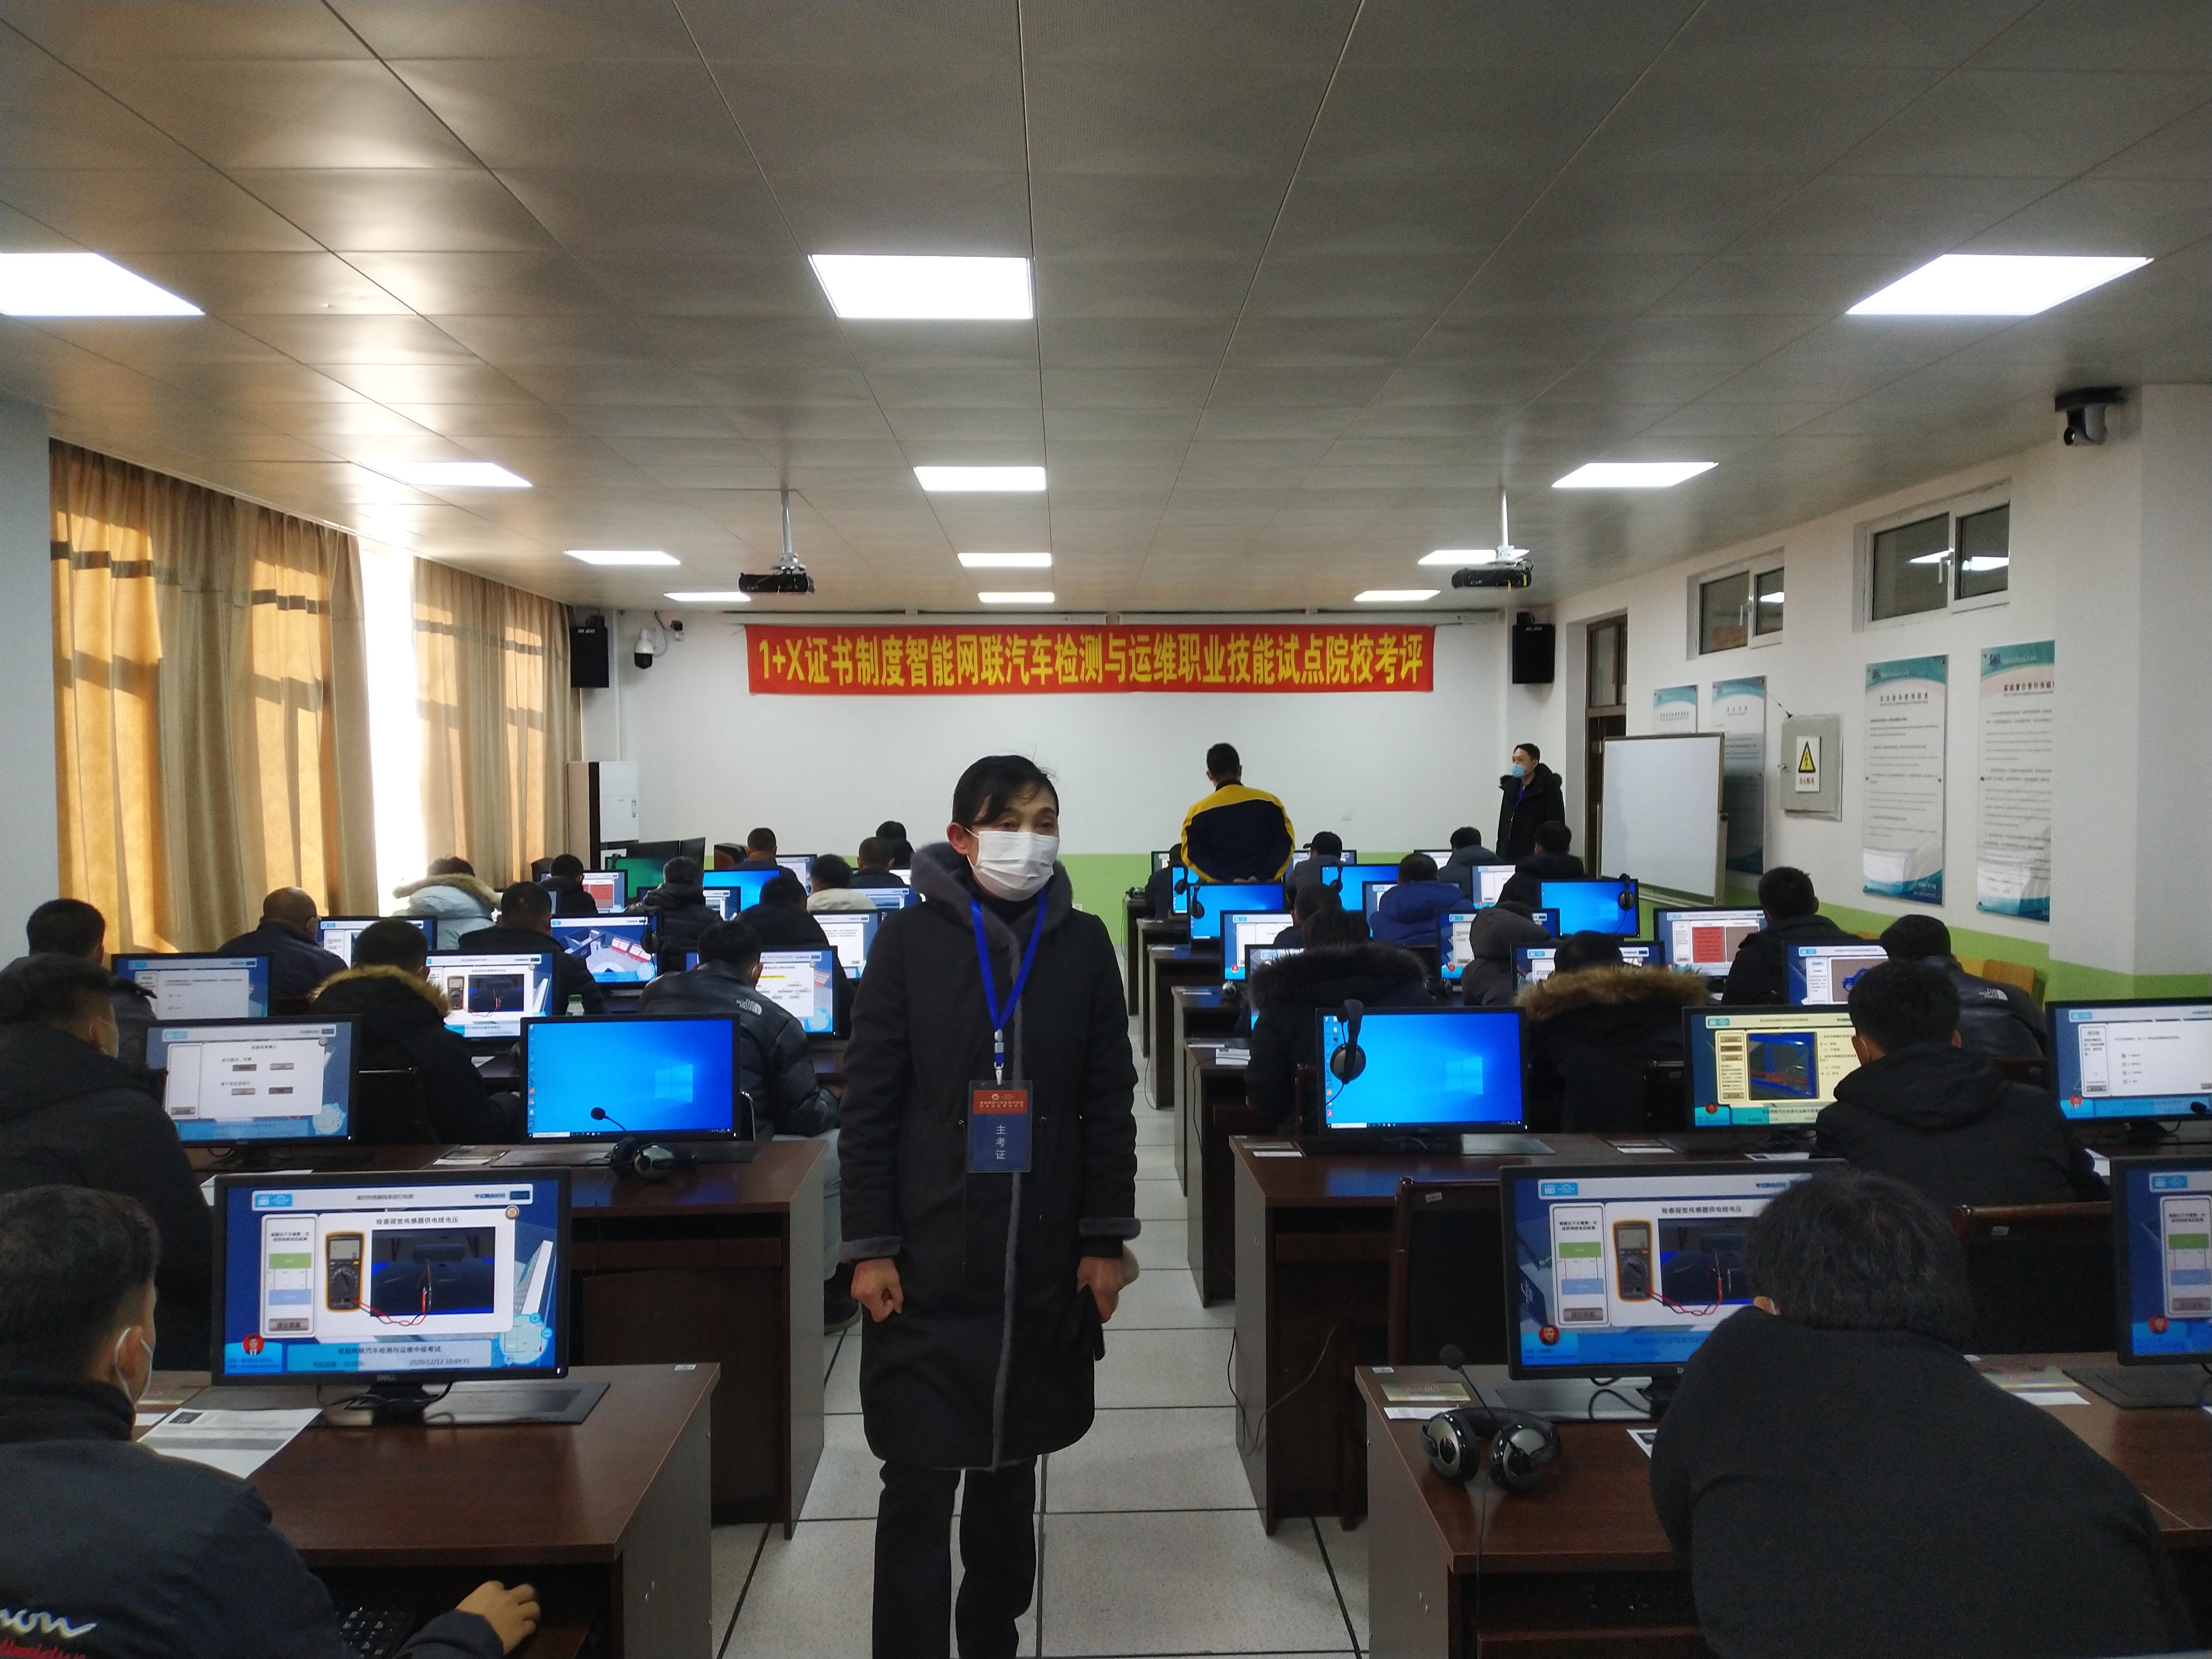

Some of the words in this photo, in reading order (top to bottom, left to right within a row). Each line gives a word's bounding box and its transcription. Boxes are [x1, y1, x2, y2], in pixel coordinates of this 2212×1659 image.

[759, 633, 1423, 686] 1+X证书制度智能网联汽车检测与运维职业技能试点院校考评
[996, 1125, 1006, 1160] 主考证
